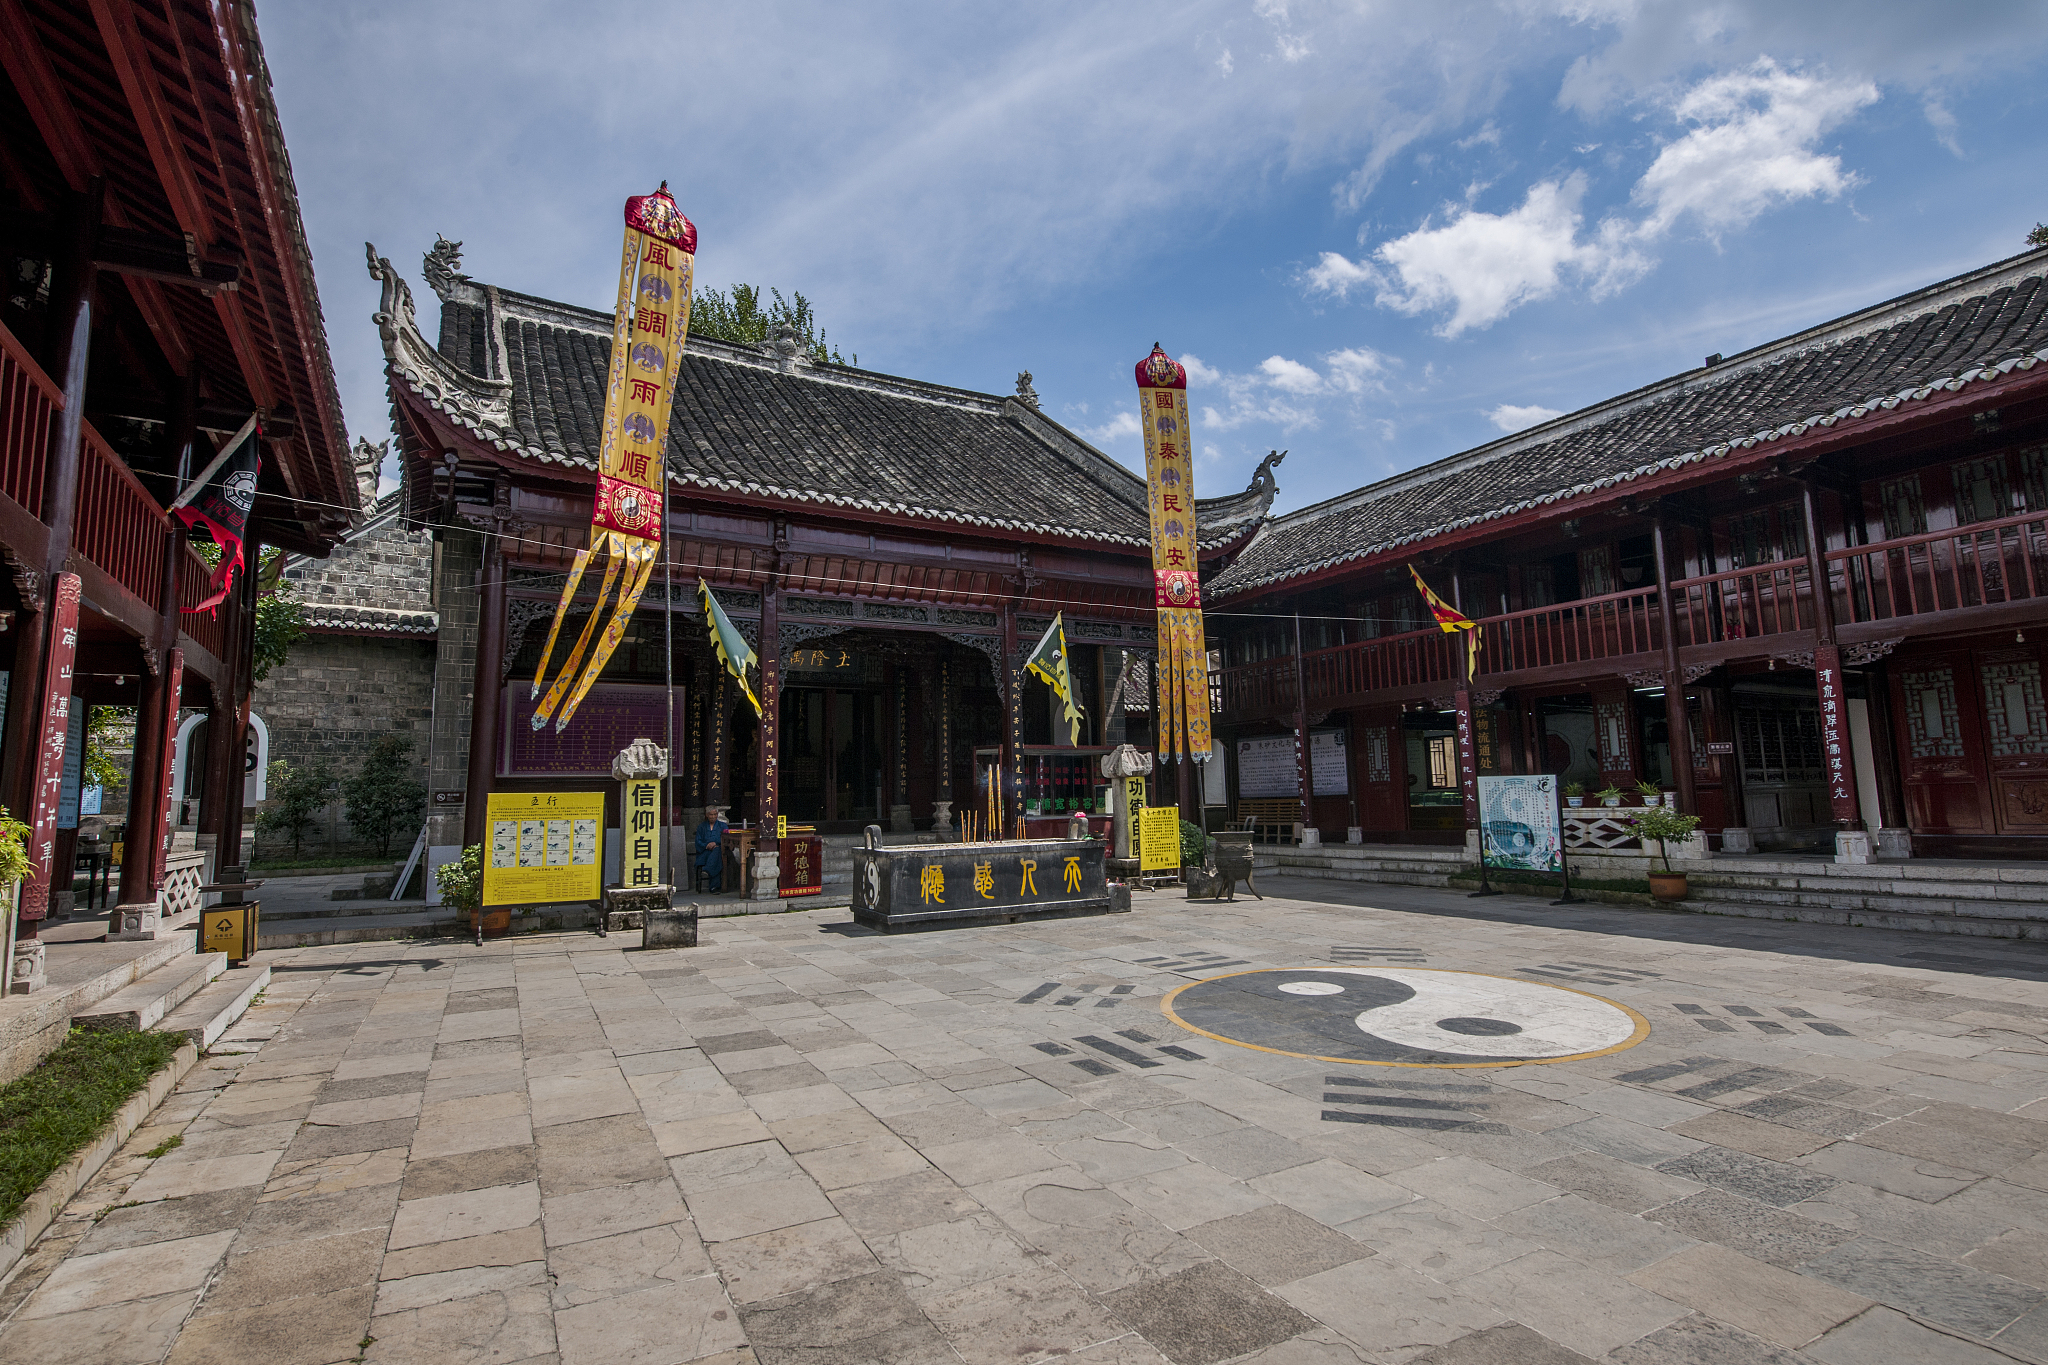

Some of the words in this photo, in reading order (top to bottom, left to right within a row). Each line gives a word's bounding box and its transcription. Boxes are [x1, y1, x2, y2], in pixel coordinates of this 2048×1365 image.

[619, 241, 674, 482] 風調雨順
[1155, 391, 1186, 567] 國泰民安
[1475, 709, 1493, 770] 法物流通处
[631, 783, 656, 886] 信仰自由
[793, 841, 810, 885] 功德箱
